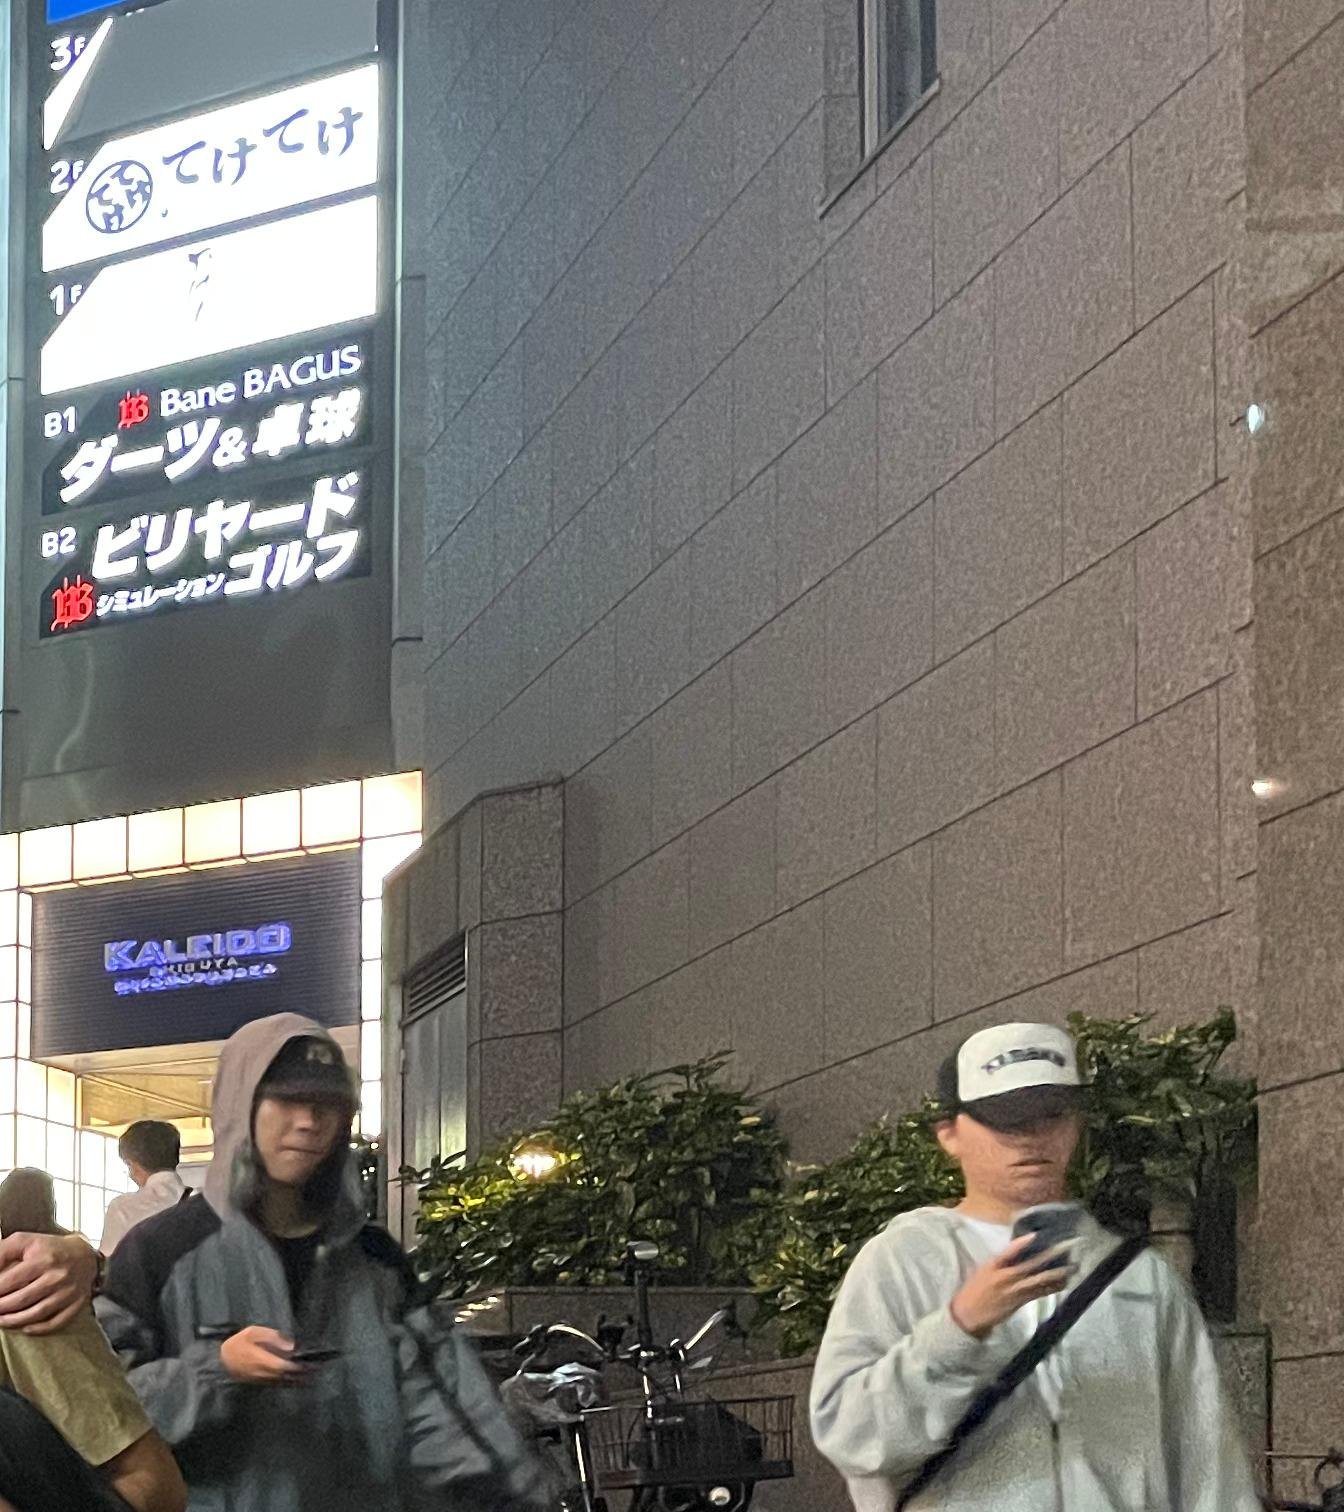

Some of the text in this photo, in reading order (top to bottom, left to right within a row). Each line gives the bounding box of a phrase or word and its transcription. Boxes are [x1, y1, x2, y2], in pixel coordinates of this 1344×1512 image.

[50, 160, 85, 194] 2F
[163, 107, 363, 186] てけてけ
[160, 345, 362, 417] Bane BAGUS
[43, 406, 77, 438] B1
[60, 387, 362, 503] ダーツ&卓球
[41, 526, 77, 558] B2
[92, 471, 359, 580] ビリヤード
[104, 921, 293, 971] KALEIDO
